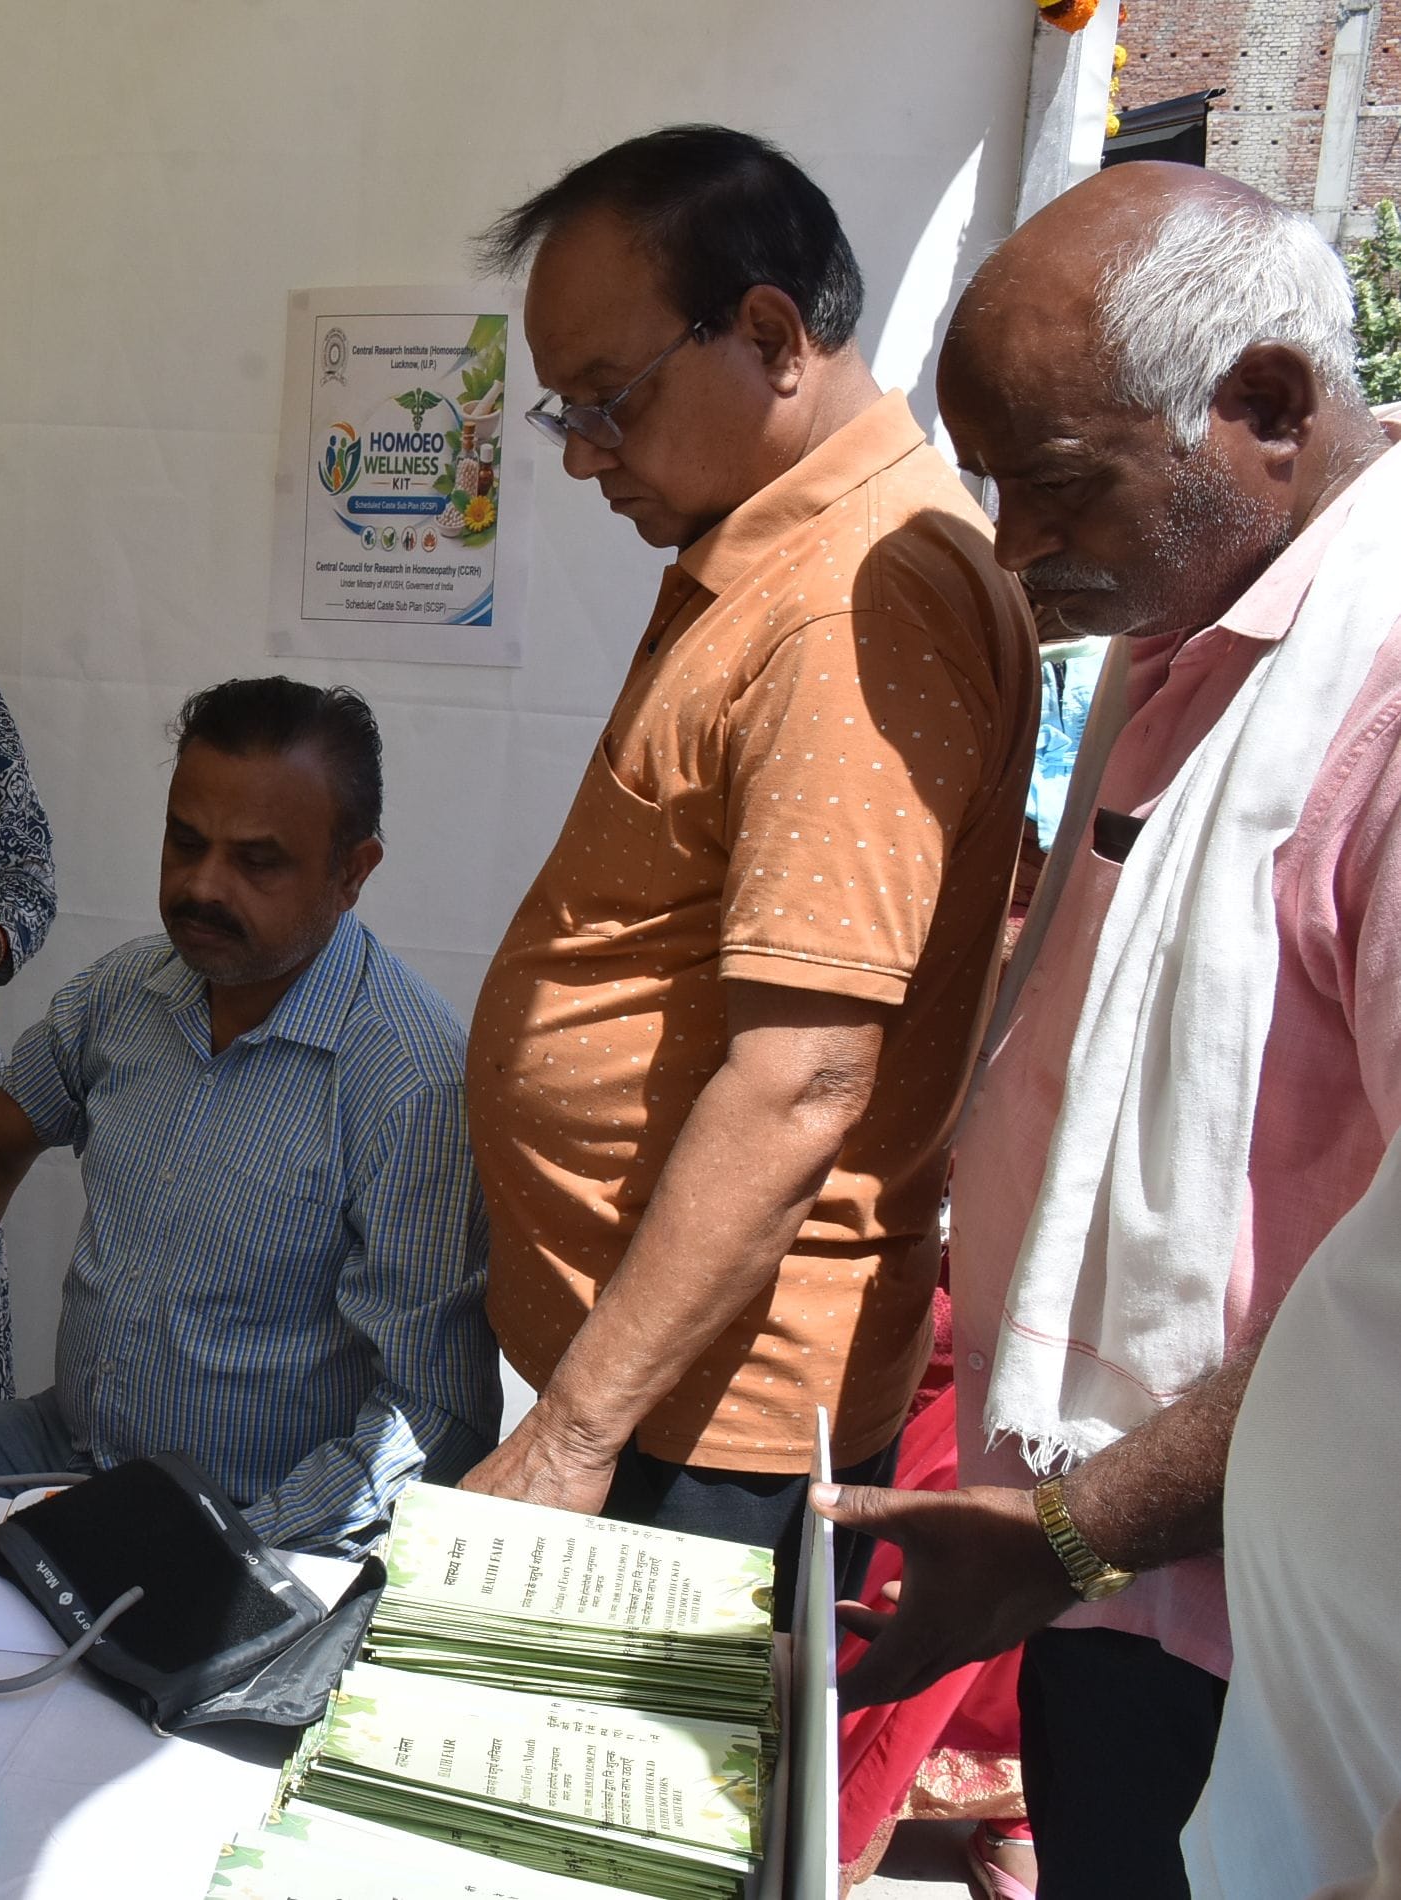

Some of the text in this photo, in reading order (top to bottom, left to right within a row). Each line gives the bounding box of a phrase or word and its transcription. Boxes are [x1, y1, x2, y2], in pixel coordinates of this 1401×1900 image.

[352, 345, 373, 355] Central
[375, 346, 402, 355] Research
[404, 346, 428, 355] Institute
[391, 360, 419, 370] Lucknow,
[370, 432, 444, 453] HOMOEO
[364, 455, 439, 475] WELLNESS
[392, 478, 411, 490] KIT
[355, 501, 381, 509] Scheduled
[397, 502, 407, 510] Sub
[407, 502, 419, 510] Plan
[316, 561, 481, 577] Central Council for Research in Homoeopathy (CCRH)
[340, 579, 356, 587] Under
[357, 580, 376, 590] Ministry
[441, 582, 453, 591] India
[345, 599, 446, 614] Scheduled Caste Sub Plan (SCSP)
[241, 1549, 259, 1565] OK
[447, 1537, 467, 1558] मेला
[531, 1536, 547, 1564] शनिवार
[562, 1537, 576, 1563] Month
[35, 1560, 59, 1590] Mark
[480, 1537, 505, 1594] HEALTH FAIR
[441, 1739, 456, 1758] FAIR
[522, 1739, 536, 1762] Month
